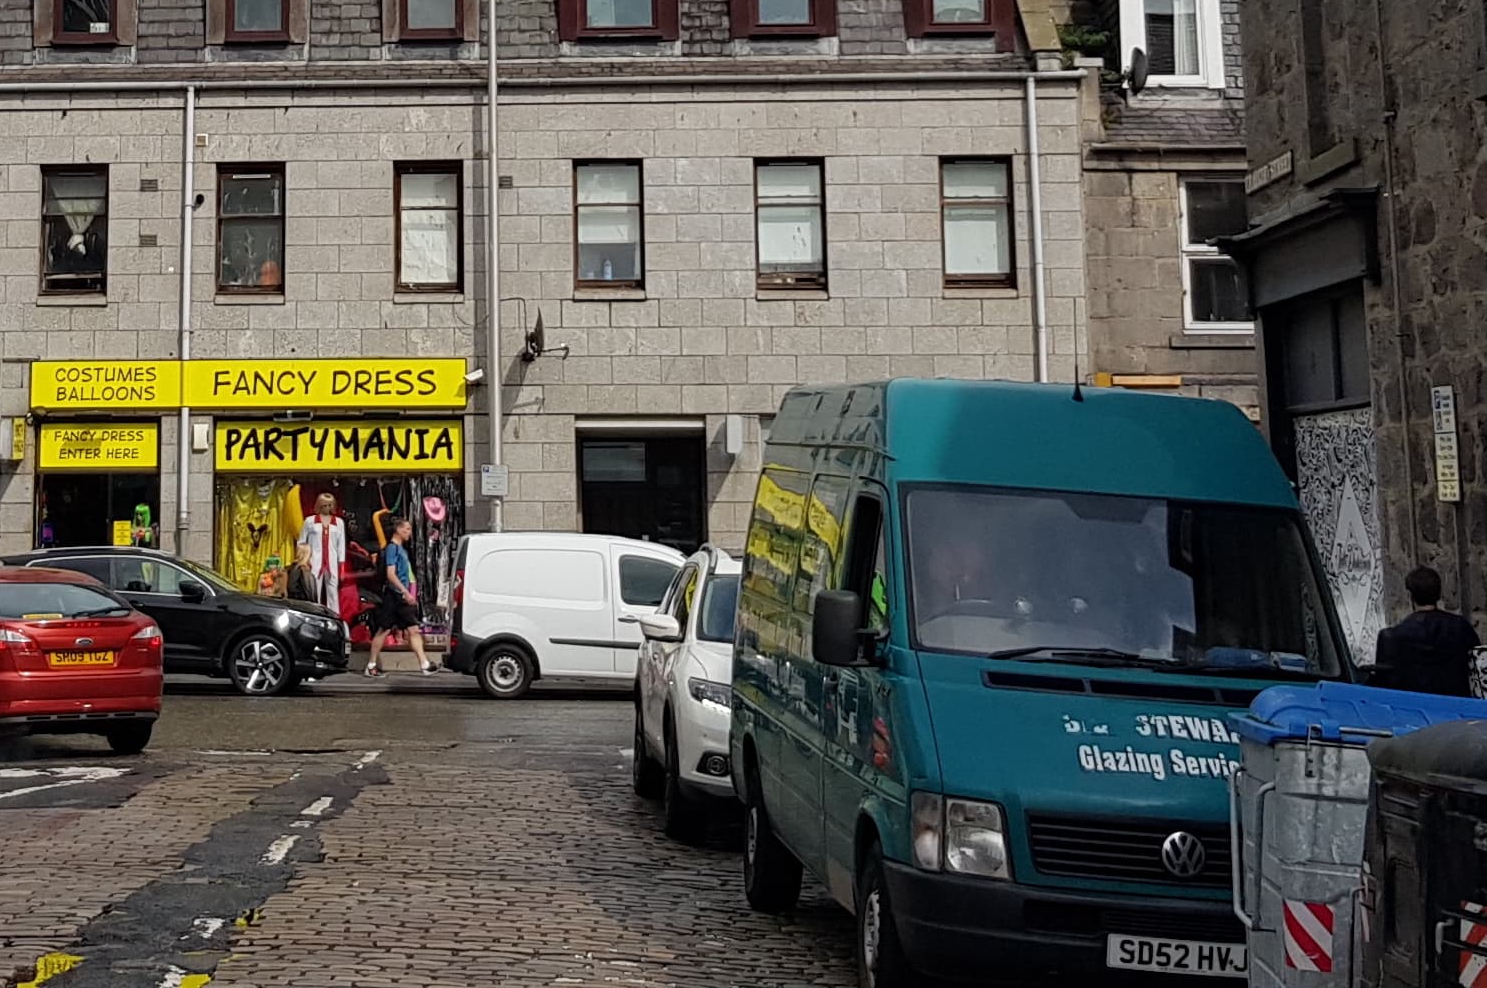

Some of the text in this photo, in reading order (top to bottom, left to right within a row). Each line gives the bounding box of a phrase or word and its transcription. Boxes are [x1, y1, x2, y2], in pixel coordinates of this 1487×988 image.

[55, 367, 157, 382] COSTUMES
[213, 370, 436, 395] FANCY DRESS
[56, 386, 156, 401] BALLOONS
[54, 430, 144, 442] FANCY DRESS
[225, 426, 454, 462] PARTYMANIA
[59, 448, 139, 459] ENTER HERE
[1078, 744, 1166, 781] Glazing
[1119, 939, 1248, 972] SD52 HVJ
